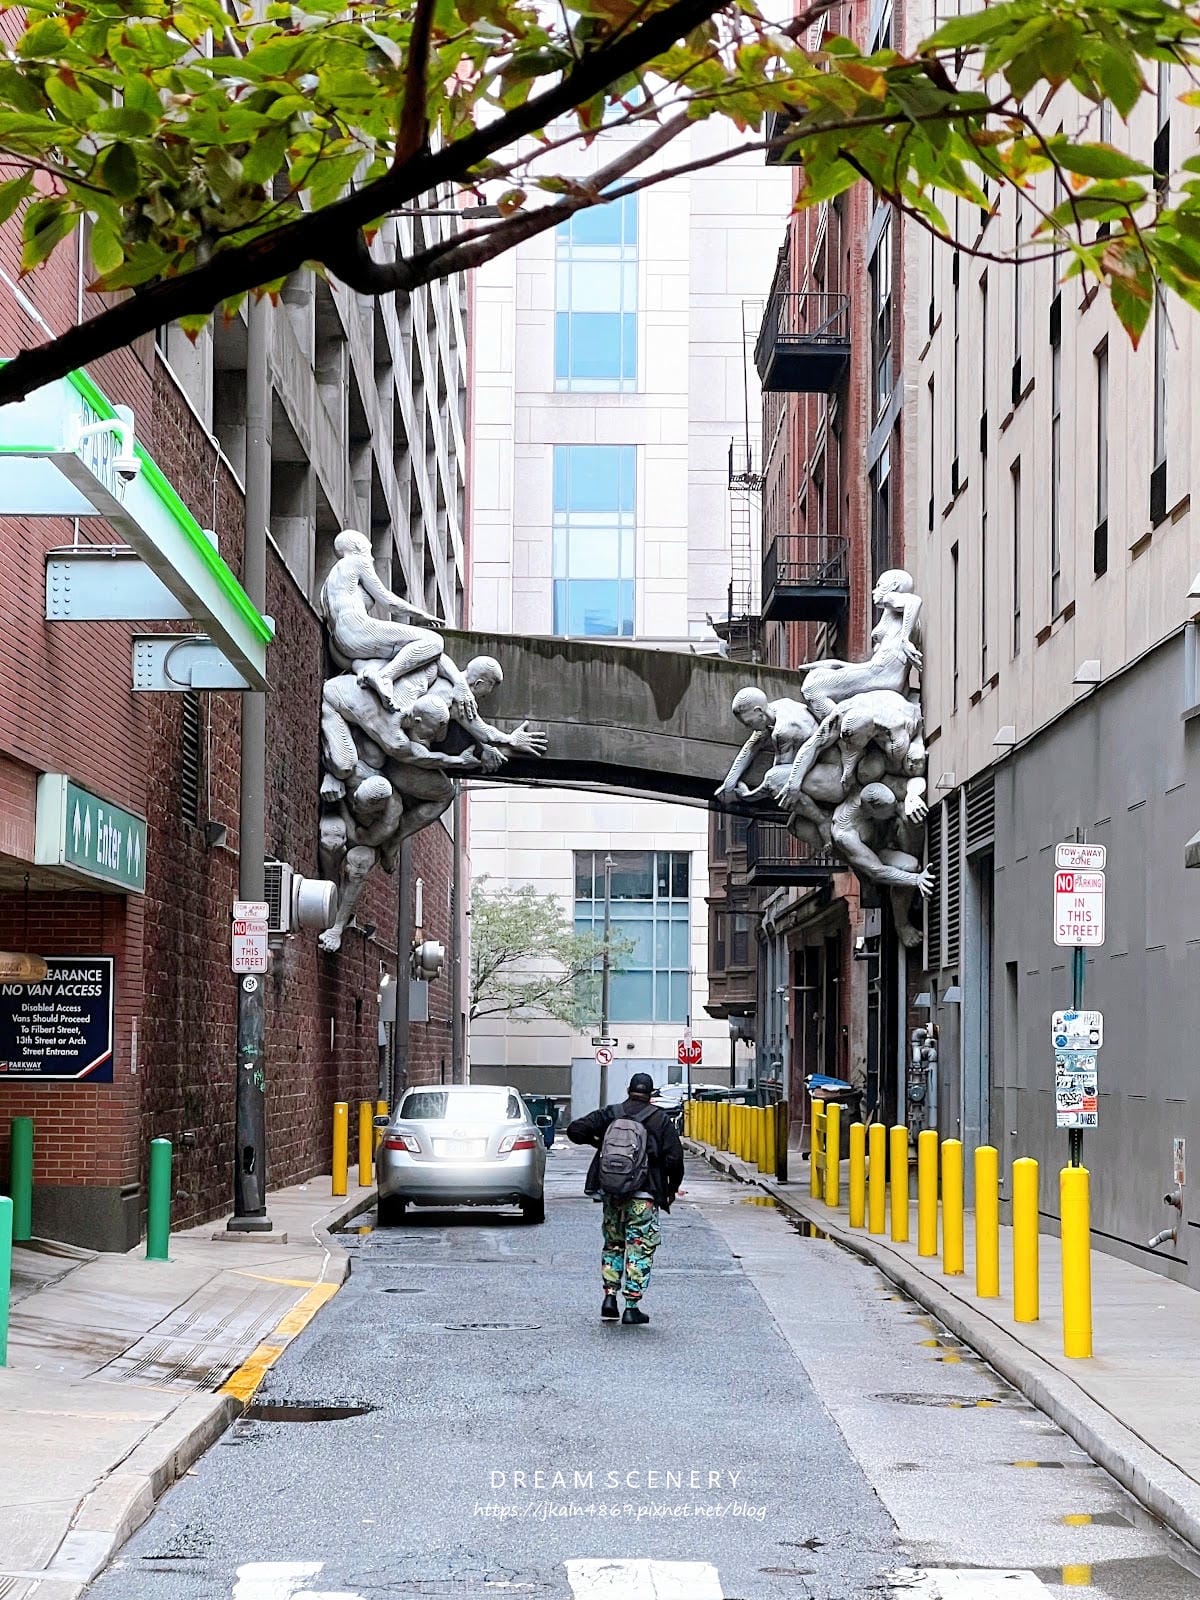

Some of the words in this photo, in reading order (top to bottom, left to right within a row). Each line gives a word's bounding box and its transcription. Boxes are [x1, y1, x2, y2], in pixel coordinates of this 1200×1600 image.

[96, 808, 122, 871] Enter
[1060, 848, 1102, 857] TOW-AWAY
[1070, 857, 1091, 866] ZONE
[1057, 875, 1073, 892] NO
[1074, 878, 1102, 888] PARKING
[1074, 898, 1085, 907] IN
[1067, 910, 1092, 922] THIS
[234, 922, 246, 935] NO
[1059, 924, 1100, 936] STREET
[246, 938, 254, 946] IN
[241, 947, 259, 956] THIS
[235, 957, 264, 966] STREET
[43, 969, 103, 981] EARANCE
[2, 984, 23, 996] NO
[27, 984, 53, 996] VAN
[55, 984, 103, 997] ACCESS
[21, 1003, 55, 1012] Disabled
[56, 1003, 82, 1012] Access
[12, 1014, 31, 1023] Vans
[32, 1014, 59, 1023] Should
[60, 1014, 91, 1023] Proceed
[21, 1026, 30, 1034] To
[31, 1025, 55, 1034] Filbert
[56, 1025, 82, 1036] Street,
[15, 1036, 33, 1045] 13th
[34, 1036, 57, 1045] Street
[68, 1036, 87, 1045] Arch
[22, 1047, 44, 1056] Street
[45, 1047, 79, 1056] Entrance
[679, 1047, 701, 1058] STOP
